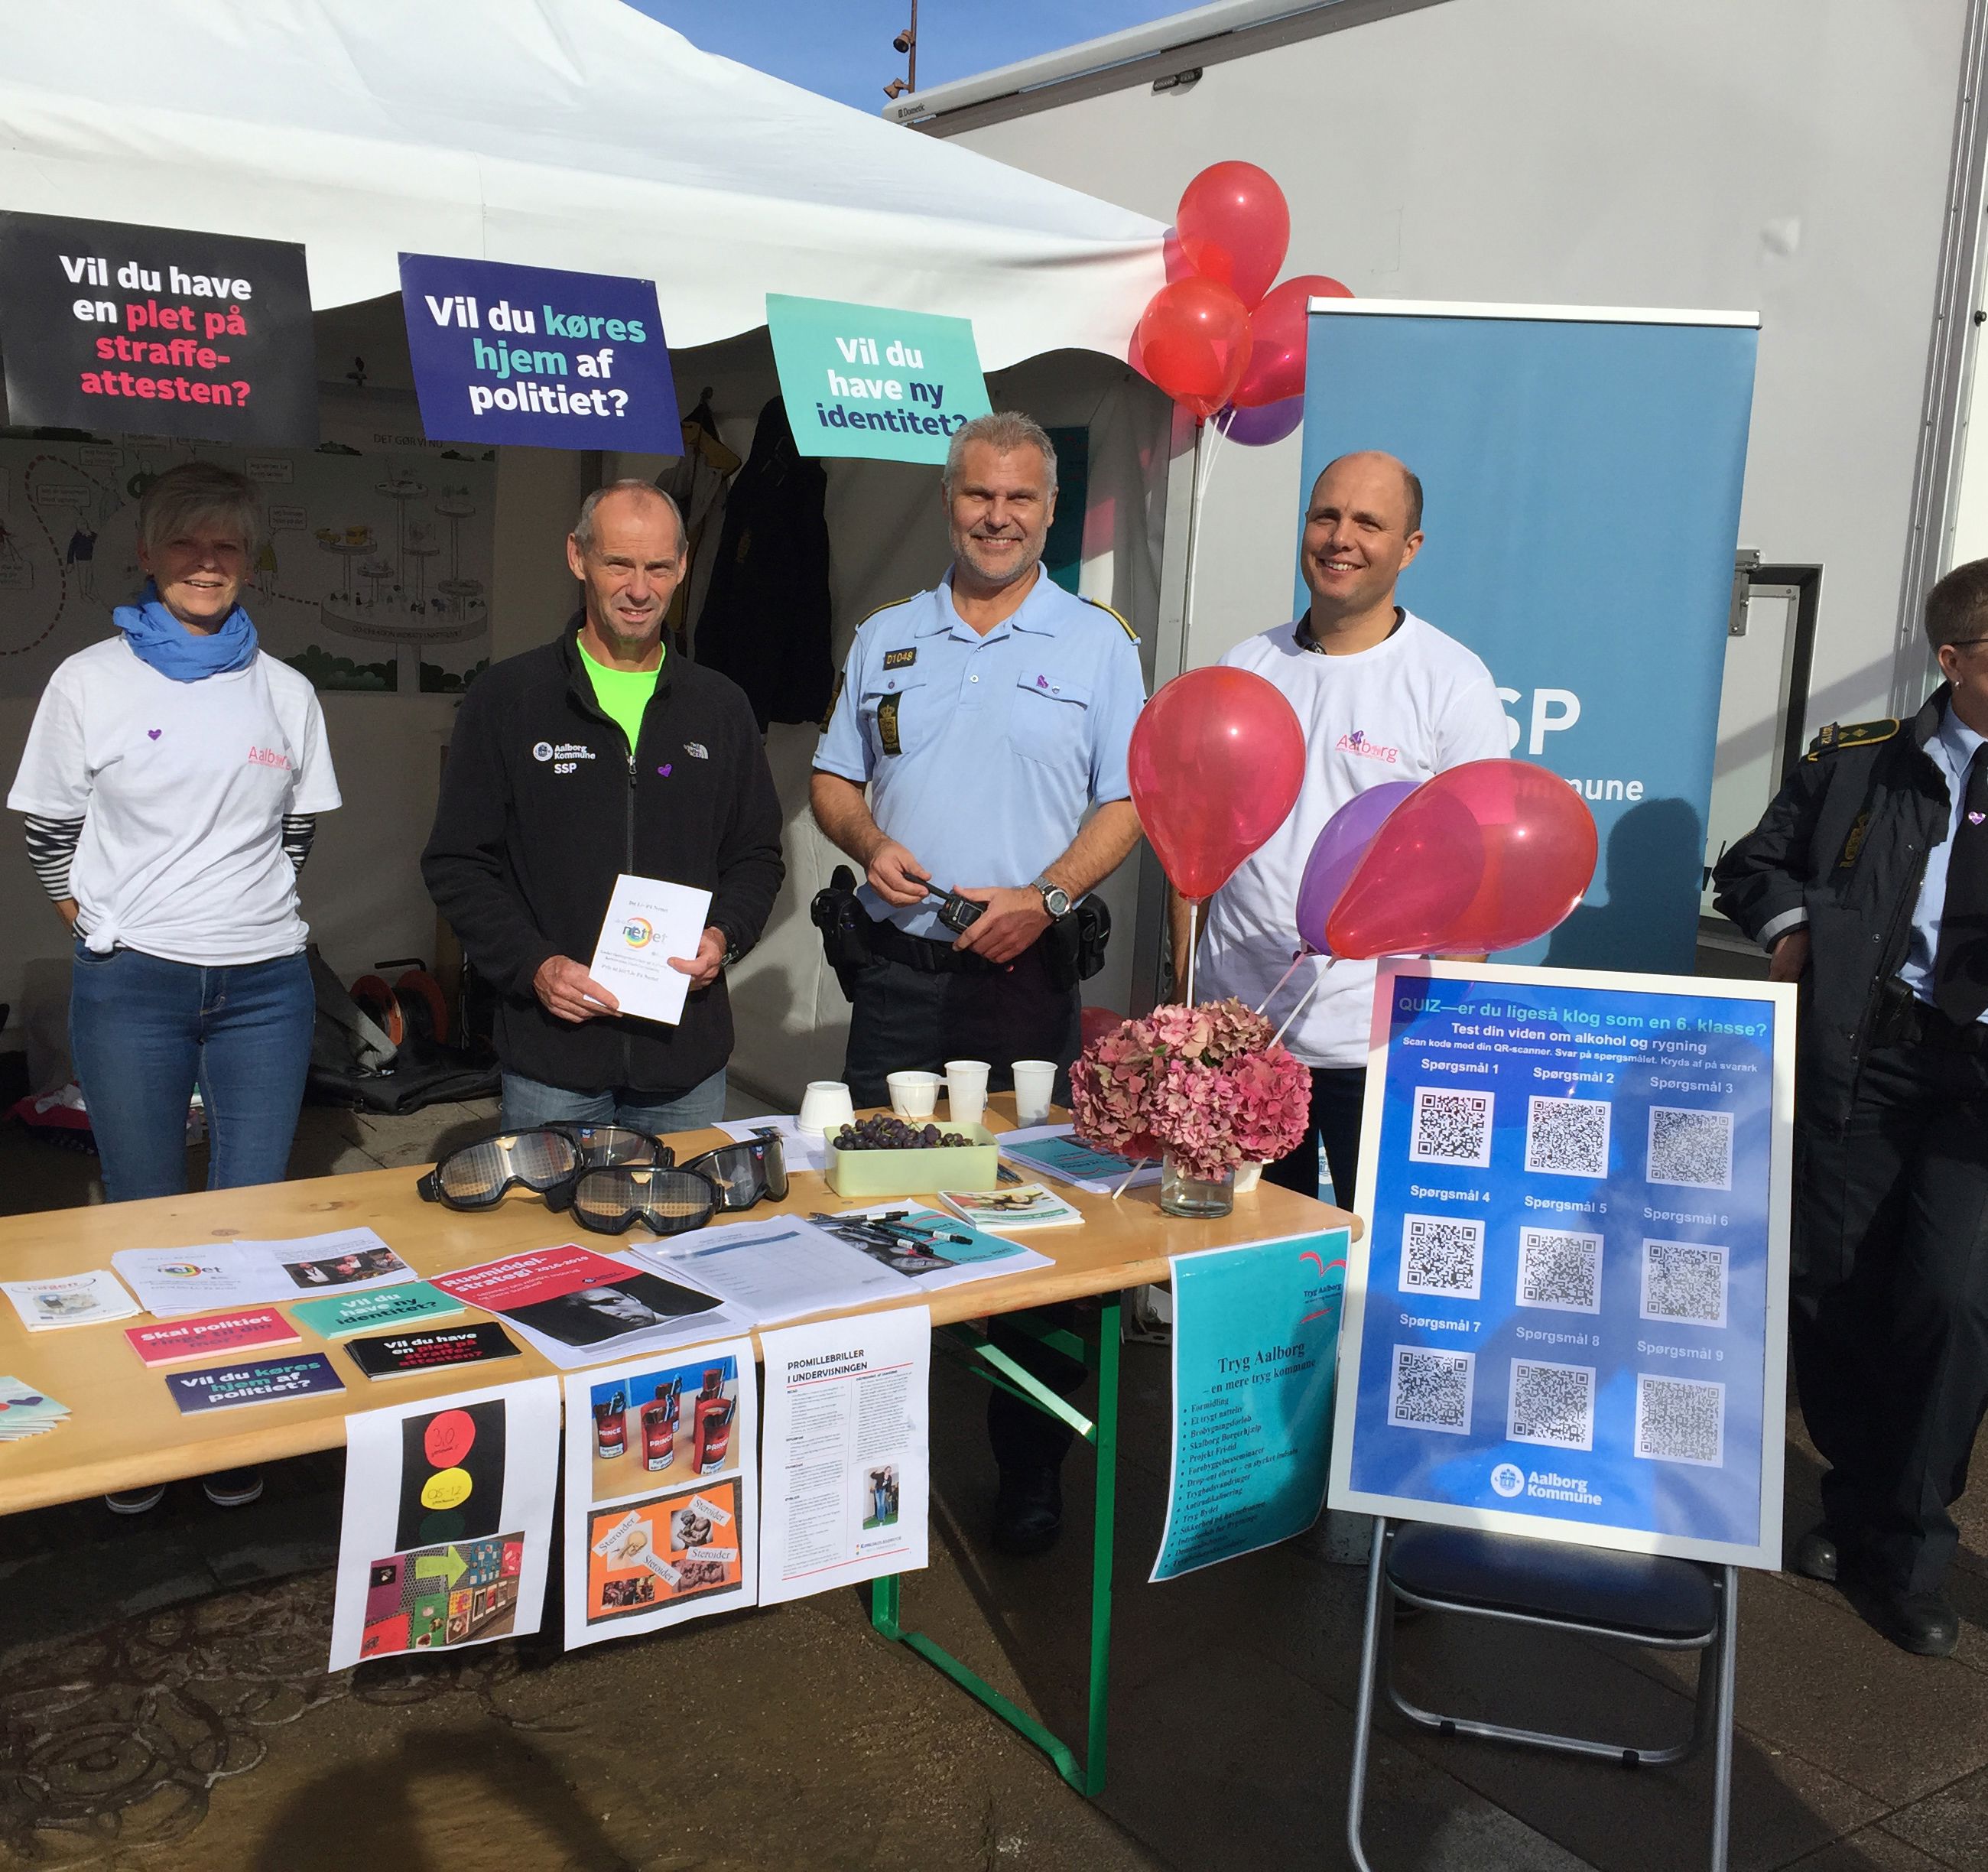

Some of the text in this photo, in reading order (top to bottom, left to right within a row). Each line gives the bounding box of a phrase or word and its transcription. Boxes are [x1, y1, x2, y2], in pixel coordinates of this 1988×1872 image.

[903, 102, 925, 117] Dometic
[59, 255, 252, 301] Vil du have
[73, 298, 247, 340] en plet på
[424, 295, 647, 343] Vil du køres
[96, 335, 231, 369] straffe-
[473, 337, 614, 379] hjem af
[835, 336, 924, 369] Vil du
[80, 370, 251, 407] attesten?
[468, 381, 629, 417] politiet?
[827, 369, 944, 410] have ny
[815, 402, 968, 437] identitet?
[374, 434, 392, 444] DET
[554, 743, 587, 753] Aalborg
[554, 750, 596, 760] Kommune
[554, 762, 577, 774] SSP
[1480, 1003, 1502, 1017] du
[1506, 1005, 1558, 1022] ligeså
[1562, 1008, 1600, 1026] klog
[1606, 1015, 1644, 1028] som
[1649, 1018, 1671, 1029] en
[1676, 1017, 1691, 1031] 6.
[1697, 1019, 1767, 1037] klasse?
[1451, 1022, 1707, 1055] Test din viden om alkohol og rygning
[1402, 1037, 1758, 1072] Scan kode med din QR-scanner. Svar på spørgsmålet. Kryds af på svarark
[1421, 1058, 1499, 1074] Spørgsmål 1
[1532, 1067, 1615, 1084] Spørgsmål 2
[1649, 1076, 1733, 1094] Spørgsmål 3
[1410, 1185, 1490, 1203] Spørgsmål 4
[1524, 1195, 1607, 1214] Spørgsmål 5
[1643, 1207, 1729, 1227] Spørgsmål 6
[440, 1256, 547, 1288] Rusmiddel-
[455, 1268, 534, 1292] strategi
[534, 1256, 590, 1273] 2016-2019
[1318, 1284, 1342, 1294] Aalborg
[335, 1302, 437, 1324] identitet?
[339, 1303, 390, 1317] have
[341, 1298, 372, 1308] Vil
[141, 1315, 272, 1341] Skal politiet
[241, 1324, 271, 1332] din
[1399, 1313, 1481, 1333] Spørgsmål 7
[384, 1340, 408, 1349] Vil
[436, 1333, 477, 1343] have
[417, 1343, 451, 1353] plet
[456, 1338, 477, 1347] på
[1515, 1326, 1600, 1347] Spørgsmål 8
[788, 1349, 865, 1370] PROMILLEBRILLER
[1217, 1342, 1305, 1373] Tryg Aalborg
[1637, 1340, 1724, 1361] Spørgsmål 9
[180, 1362, 321, 1387] Vil du køres
[210, 1372, 300, 1392] hjem af
[788, 1361, 868, 1383] I UNDERVISNINGEN
[1211, 1383, 1223, 1394] en
[1225, 1378, 1249, 1391] mere
[1252, 1371, 1271, 1384] tryg
[1273, 1360, 1315, 1378] kommune
[208, 1380, 311, 1403] politiet?
[1191, 1397, 1229, 1412] Formidling
[1191, 1416, 1199, 1425] Et
[1200, 1412, 1217, 1422] trygt
[599, 1427, 622, 1436] PRINCE
[1190, 1437, 1220, 1450] Skalborg
[1189, 1450, 1214, 1463] Projekt
[1528, 1471, 1588, 1493] Aalborg
[1527, 1484, 1603, 1506] Kommune
[695, 1499, 725, 1522] Steroider
[599, 1516, 635, 1551] Steroider
[692, 1549, 731, 1559] Steroider
[643, 1555, 674, 1581] Steroider
